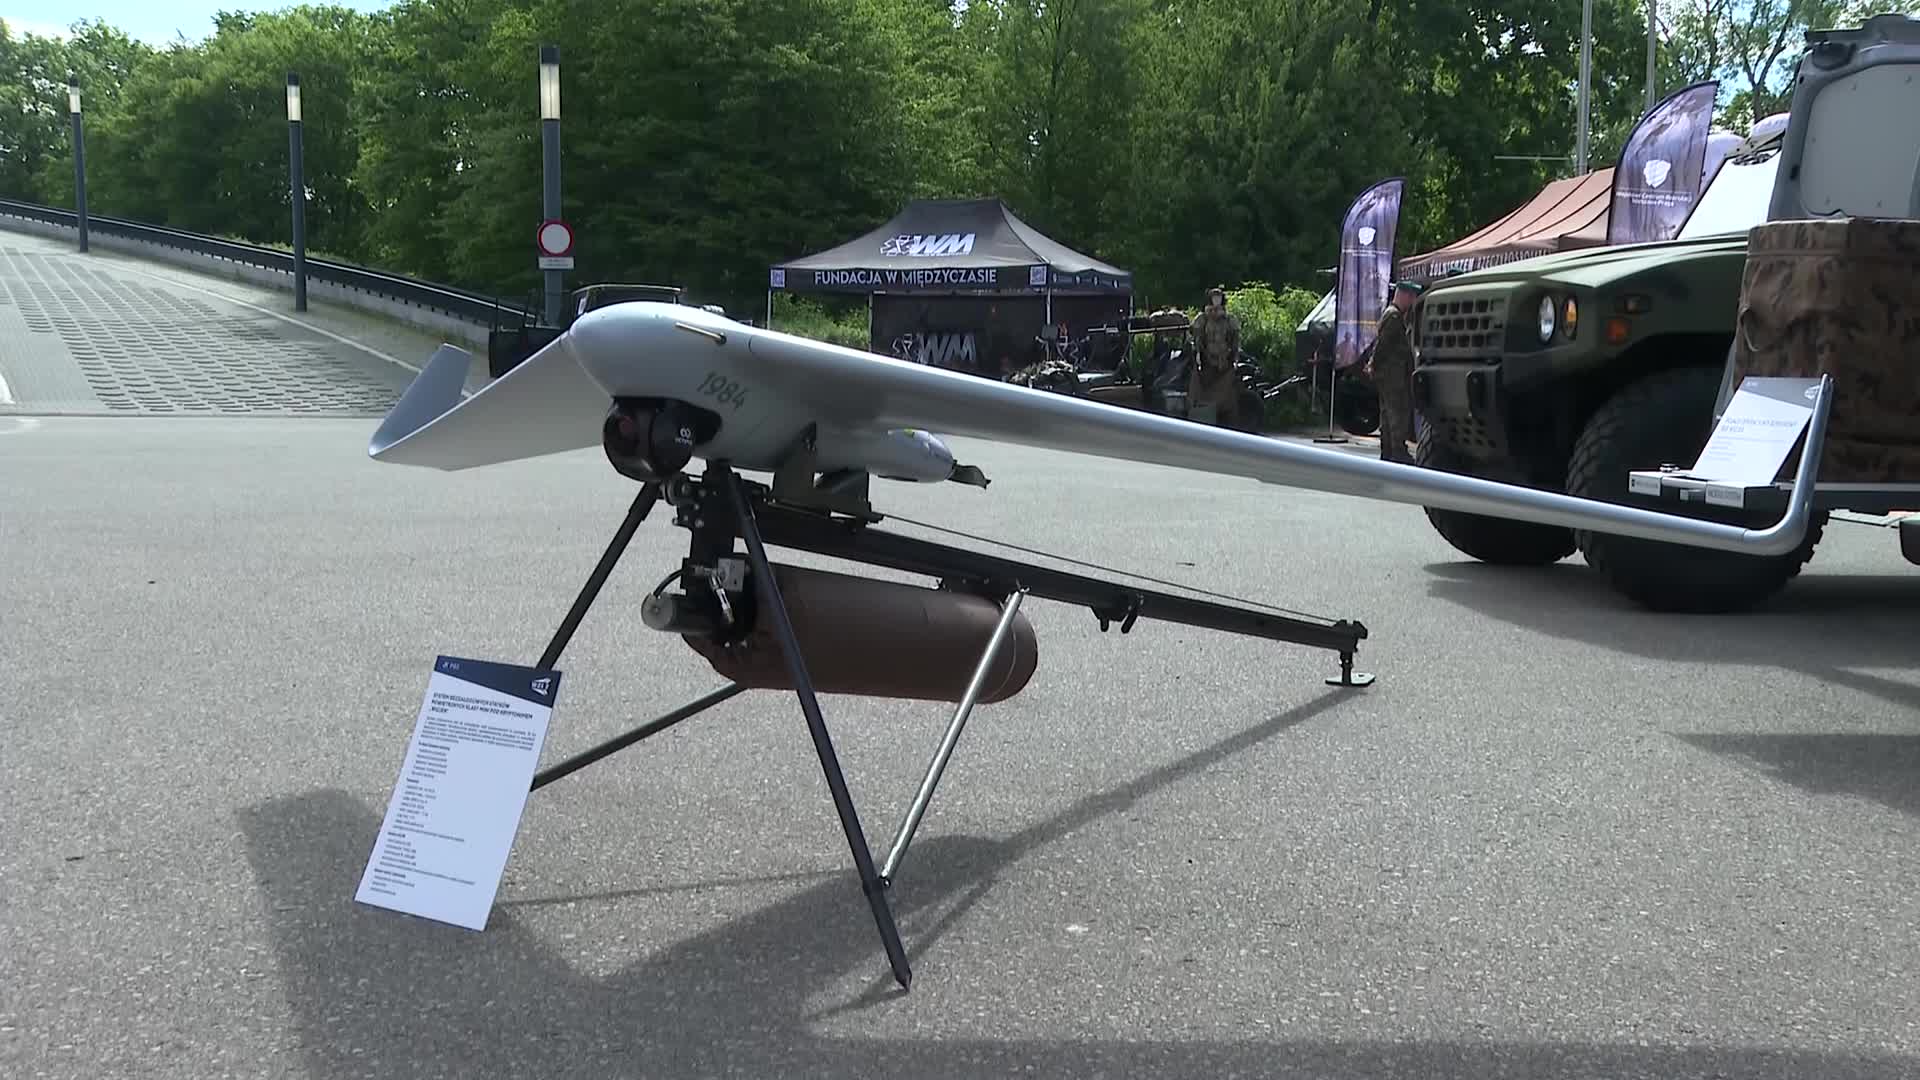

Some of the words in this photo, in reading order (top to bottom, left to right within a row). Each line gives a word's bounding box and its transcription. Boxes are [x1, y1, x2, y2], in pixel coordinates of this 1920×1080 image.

[814, 271, 882, 285] FUNDACJA
[885, 271, 899, 284] W
[902, 269, 997, 288] MIĘDZYCZASIE
[697, 372, 746, 410] 1984
